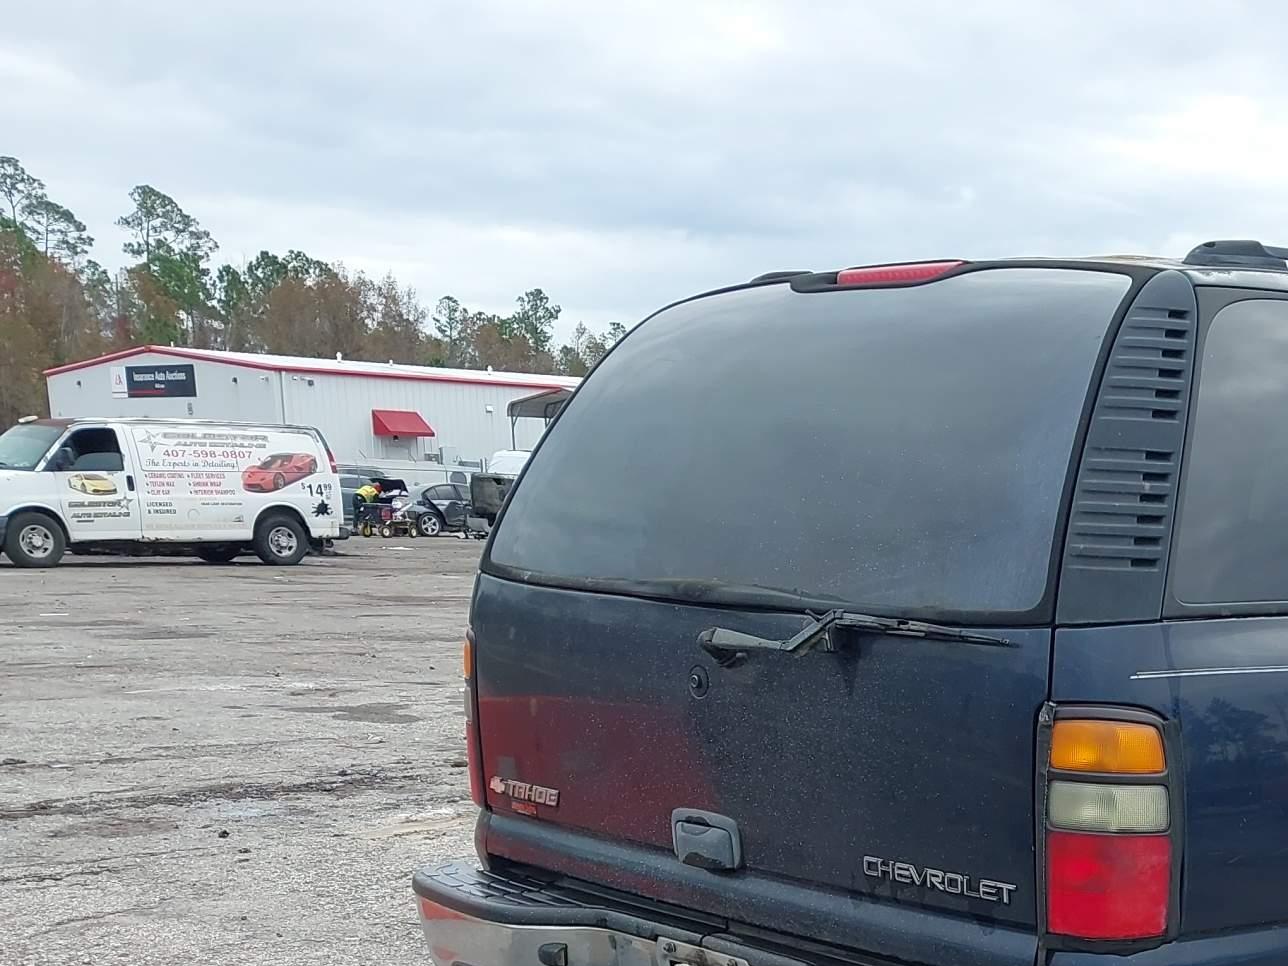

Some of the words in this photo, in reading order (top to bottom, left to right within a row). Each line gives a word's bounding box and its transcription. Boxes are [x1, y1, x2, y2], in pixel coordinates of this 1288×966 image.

[163, 449, 252, 459] 407-598-0807
[146, 458, 160, 467] The
[162, 459, 190, 469] Experts
[192, 460, 199, 468] in
[502, 780, 559, 806] TAHOE
[863, 855, 1017, 904] CHEVROLET
